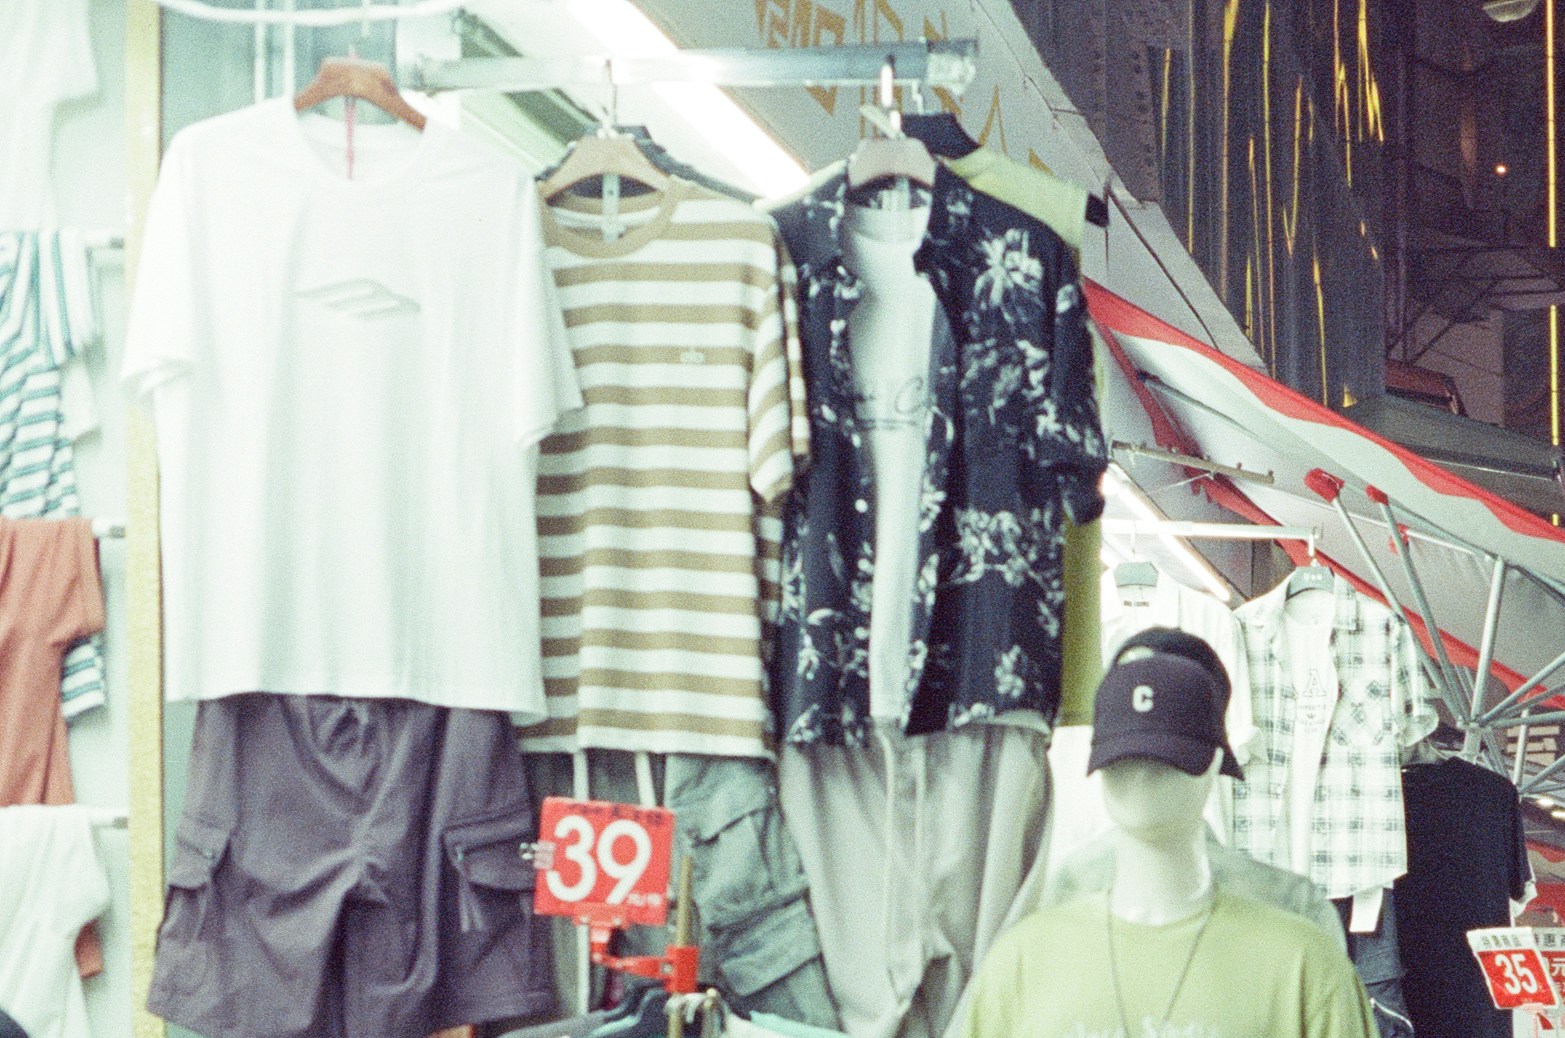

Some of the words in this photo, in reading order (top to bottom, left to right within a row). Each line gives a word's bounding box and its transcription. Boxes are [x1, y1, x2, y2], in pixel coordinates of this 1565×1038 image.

[1132, 685, 1154, 713] C
[546, 815, 652, 905] 39
[1494, 953, 1539, 995] 35
